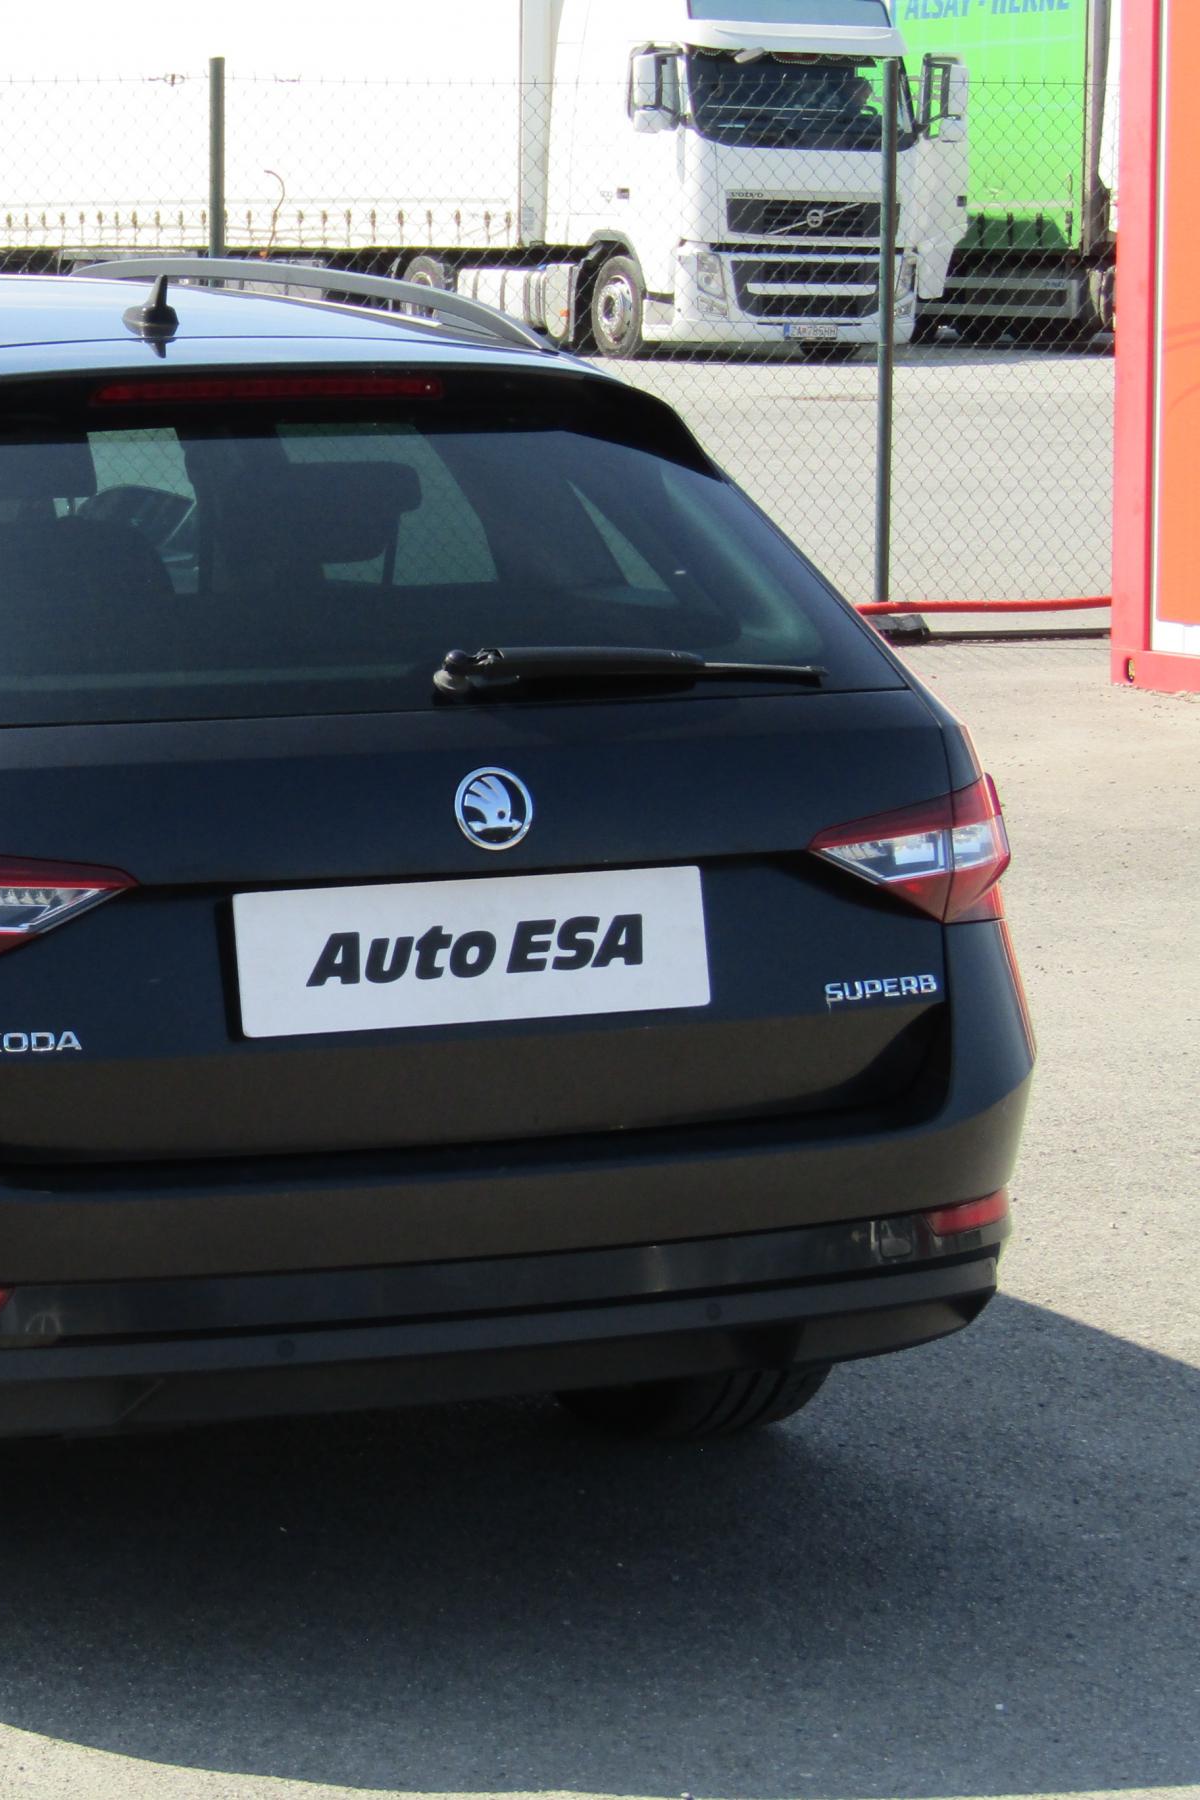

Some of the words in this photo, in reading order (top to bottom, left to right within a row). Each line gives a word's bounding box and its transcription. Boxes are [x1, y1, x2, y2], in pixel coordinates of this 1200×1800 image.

[306, 925, 497, 987] Auto
[506, 913, 643, 973] ESA
[824, 974, 937, 1004] SUPERB
